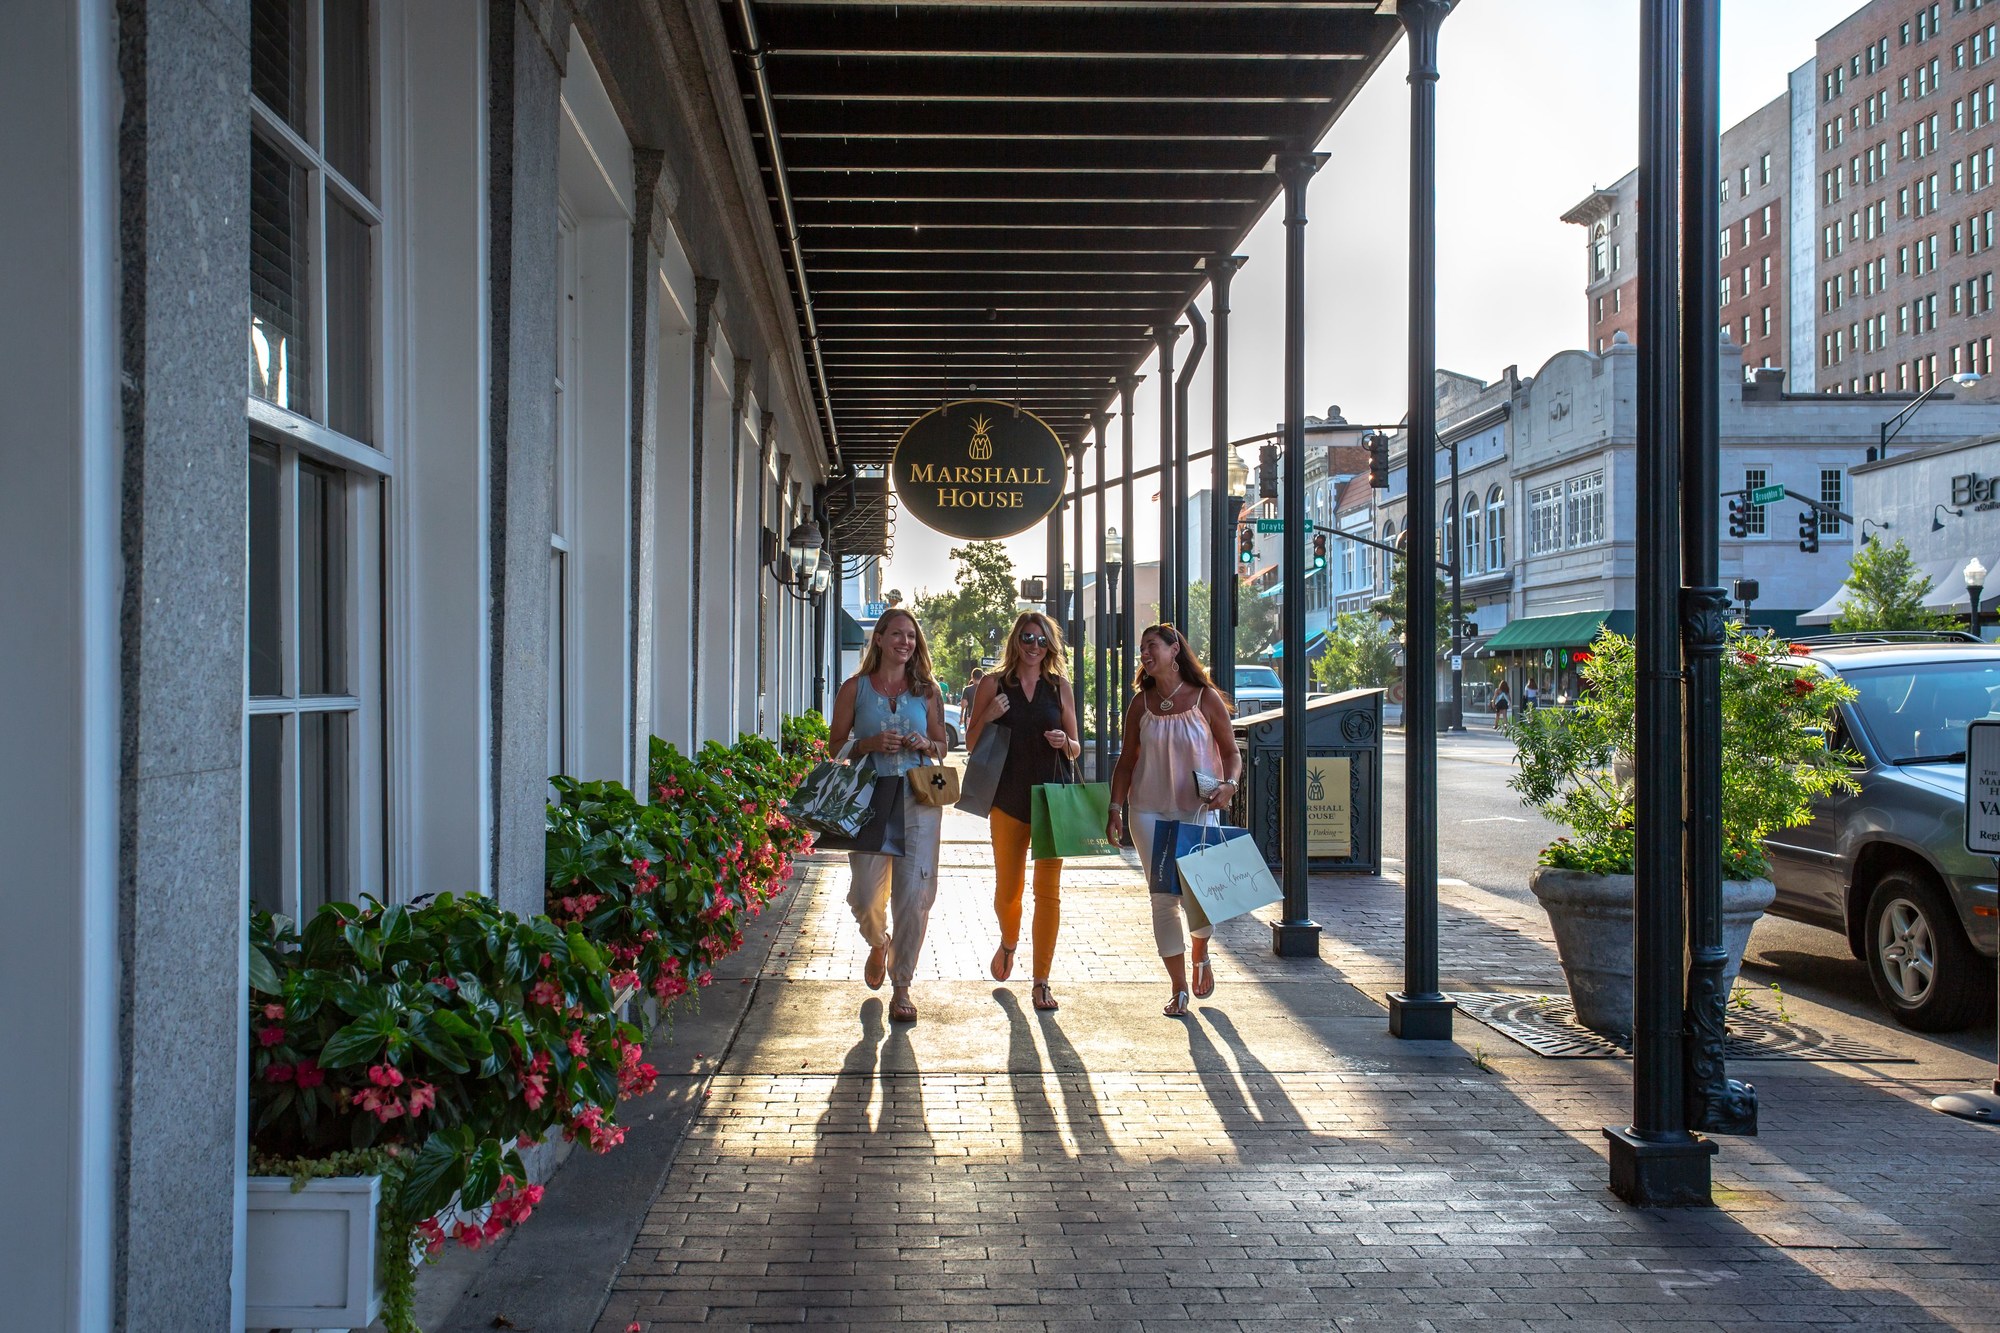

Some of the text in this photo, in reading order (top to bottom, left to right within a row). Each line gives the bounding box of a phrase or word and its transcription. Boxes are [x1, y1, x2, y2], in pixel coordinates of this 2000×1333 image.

[909, 463, 1051, 484] MARSHALL
[937, 488, 1024, 508] HOUSE
[1261, 522, 1284, 531] Drayto
[1313, 829, 1337, 837] Parking
